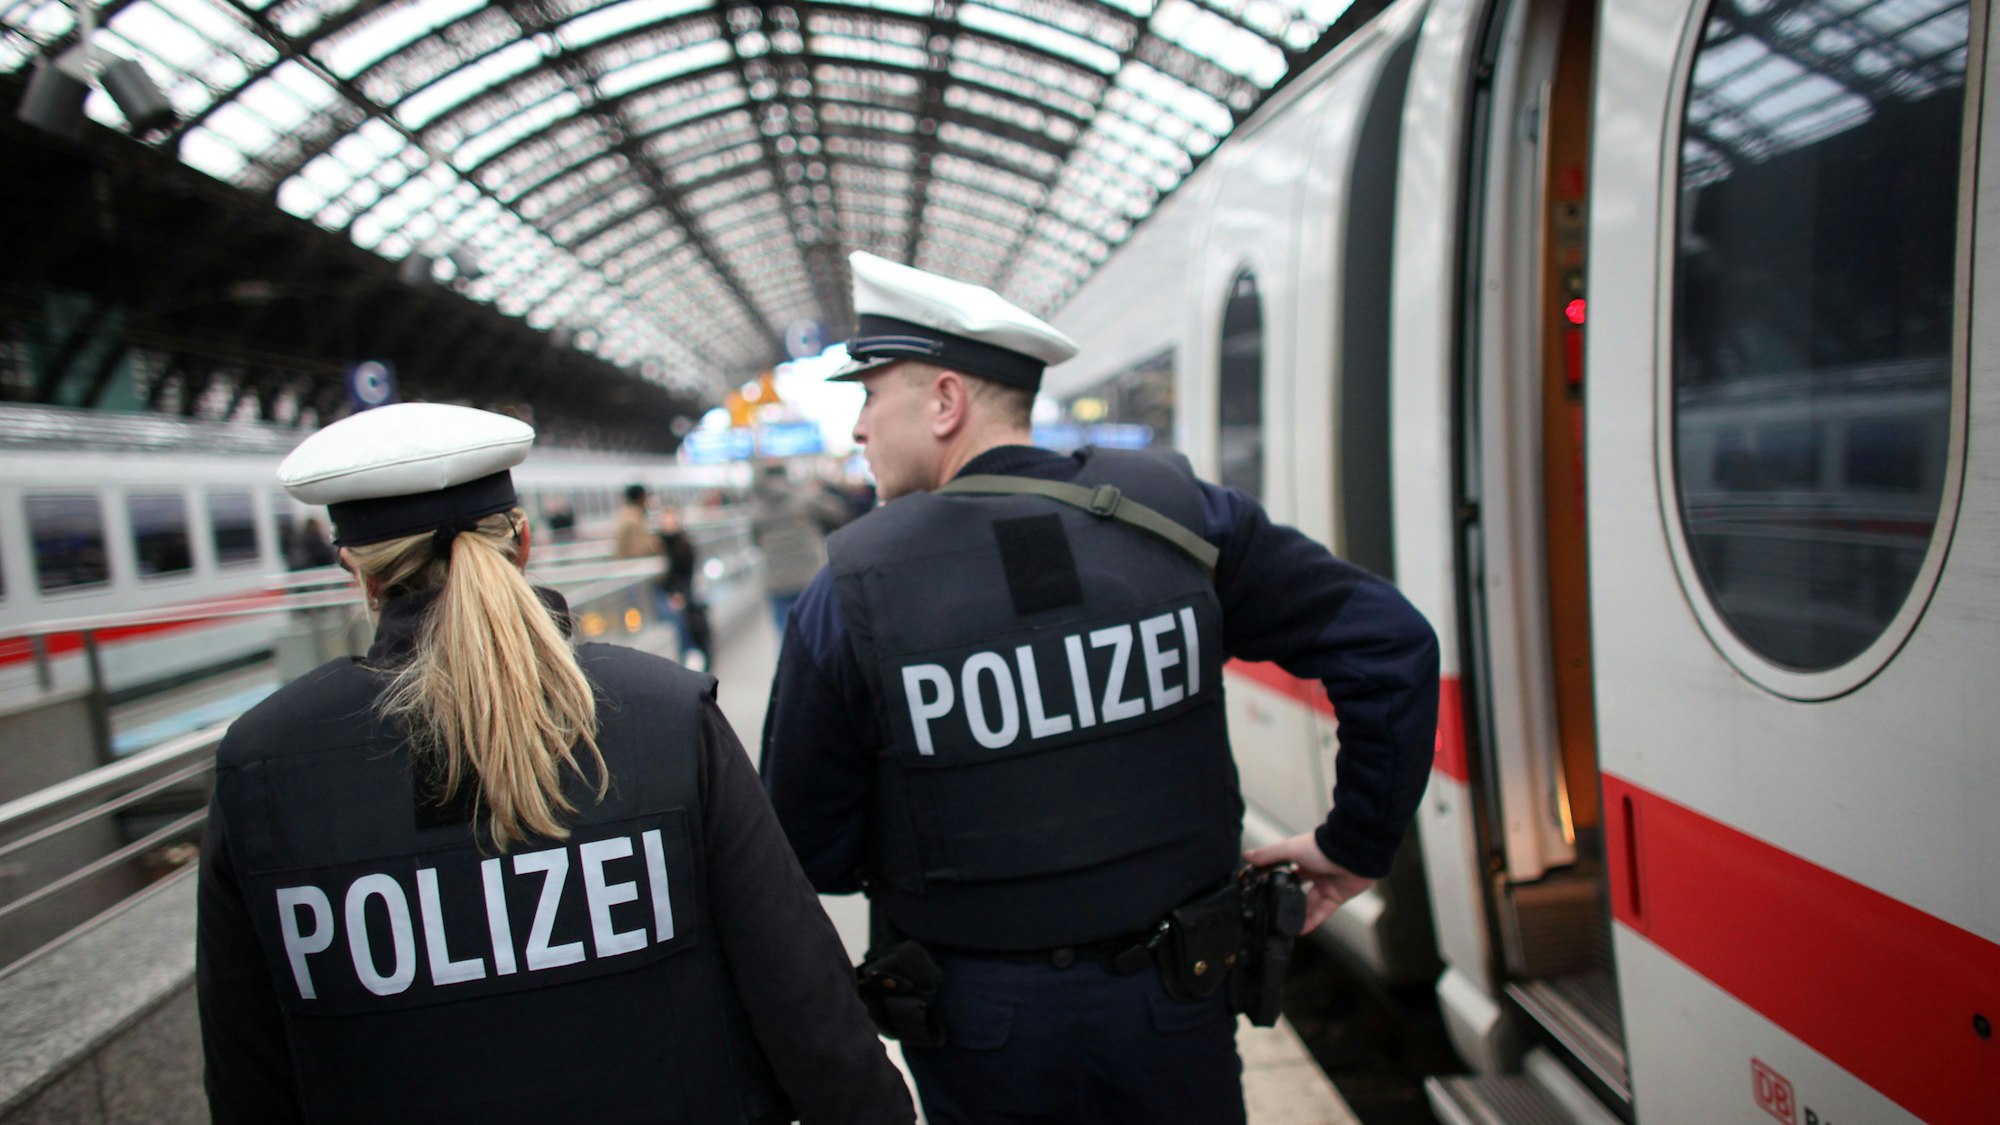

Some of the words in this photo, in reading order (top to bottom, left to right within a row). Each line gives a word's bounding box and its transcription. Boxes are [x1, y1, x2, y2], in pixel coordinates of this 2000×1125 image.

[355, 361, 390, 404] C
[902, 606, 1200, 756] POLIZEI
[276, 829, 675, 999] POLIZEI
